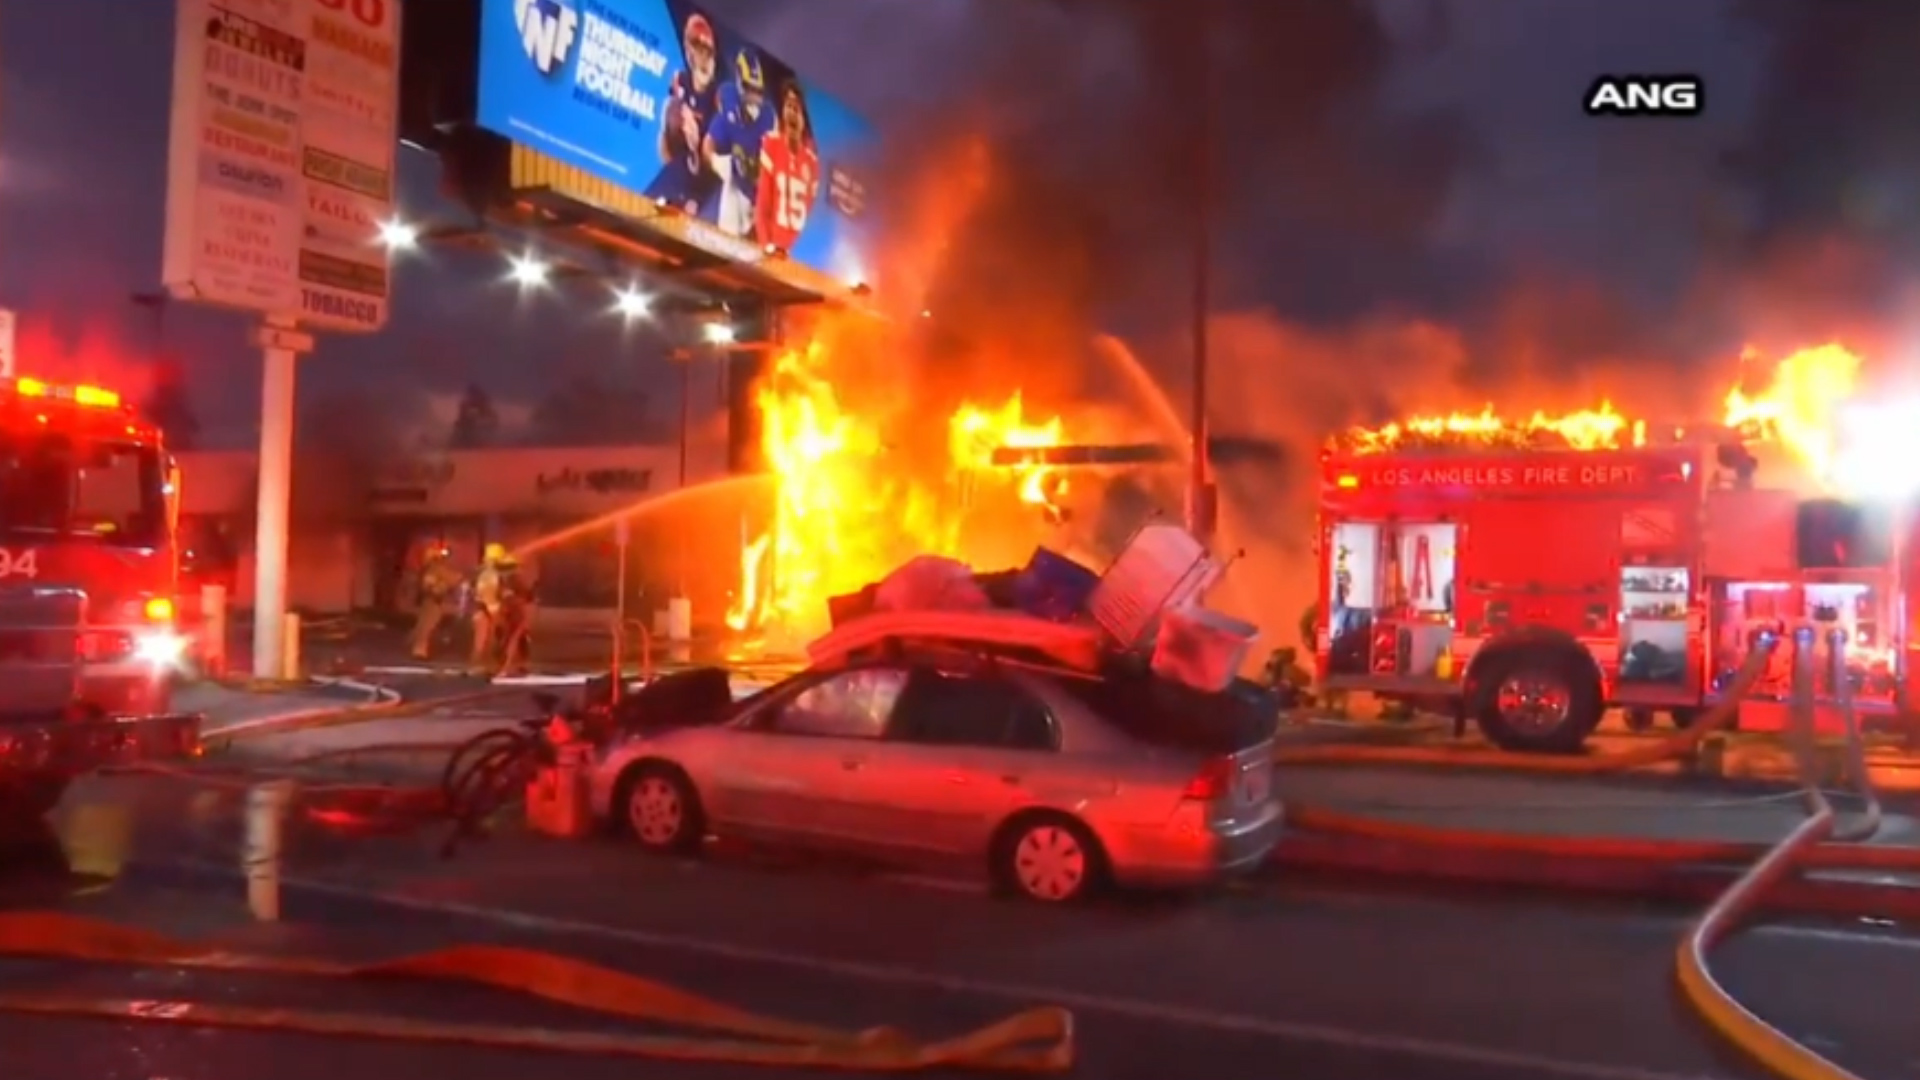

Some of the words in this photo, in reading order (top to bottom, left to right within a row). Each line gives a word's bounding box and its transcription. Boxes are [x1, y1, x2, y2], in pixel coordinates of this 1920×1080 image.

[581, 38, 632, 84] NIGHT
[584, 11, 668, 78] THURSDAY
[575, 60, 655, 121] FOOTBALL
[776, 171, 808, 231] 15
[301, 288, 378, 324] TOBACCO
[1373, 469, 1410, 485] LOS
[1419, 467, 1514, 485] ANGELES
[1524, 467, 1570, 484] FIRE
